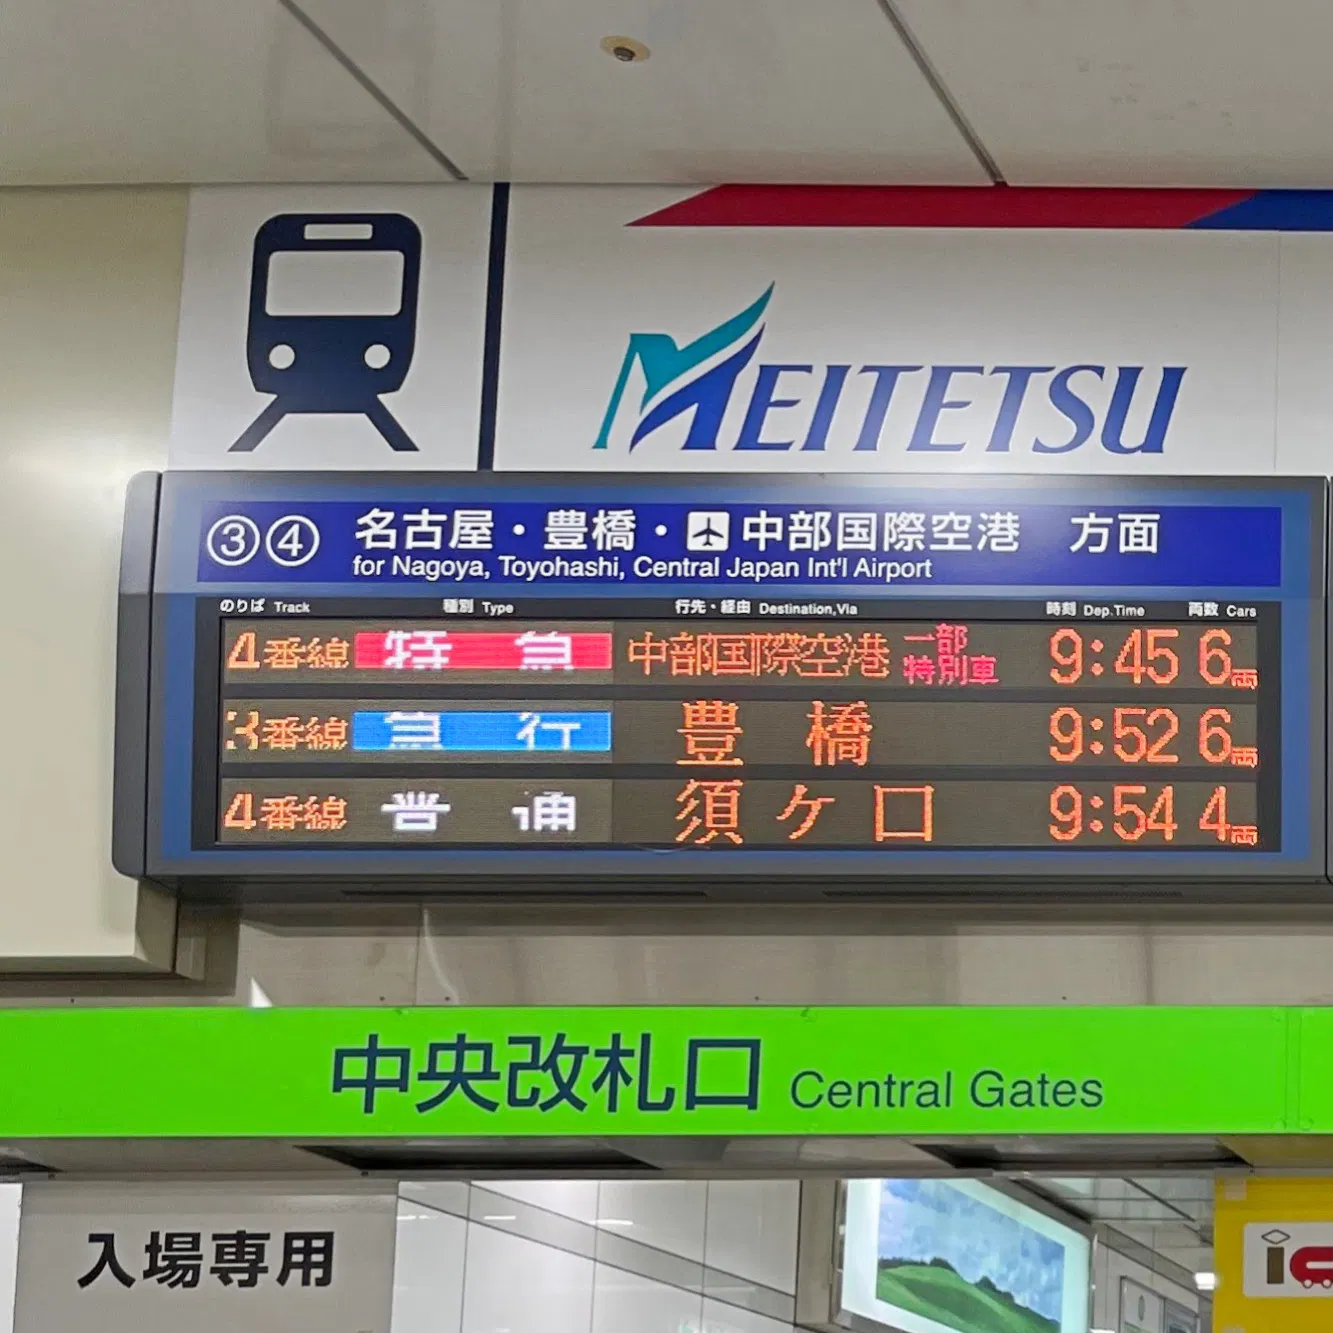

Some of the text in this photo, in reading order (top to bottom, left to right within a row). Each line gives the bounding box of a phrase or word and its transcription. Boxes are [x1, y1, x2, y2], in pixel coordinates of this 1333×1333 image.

[592, 281, 1189, 456] MEITETSU
[742, 510, 1161, 554] 中部国際空港 方面
[352, 555, 933, 583] for Nagoya, Toyohashi, Central Japan Int'l Airport
[219, 598, 265, 614] のりば
[273, 601, 311, 613] Track
[443, 598, 474, 615] 種別
[481, 602, 514, 616] Type
[1046, 601, 1077, 617] 時刻
[1083, 604, 1146, 619] Dep.Time
[1188, 601, 1219, 617] 両数
[1226, 604, 1257, 617] Cars
[226, 632, 350, 670] 4番線
[383, 630, 578, 670] 特急
[627, 632, 892, 679] 中部国際空港
[1048, 628, 1181, 686] 9:45
[383, 711, 582, 751] 急行
[675, 699, 875, 768] 豊橋
[1048, 706, 1181, 766] 9:52
[223, 784, 1179, 845] 4番線 9:54
[331, 1034, 1104, 1113] 中央改札口 Central Gates
[77, 1230, 336, 1291] 入場専用
